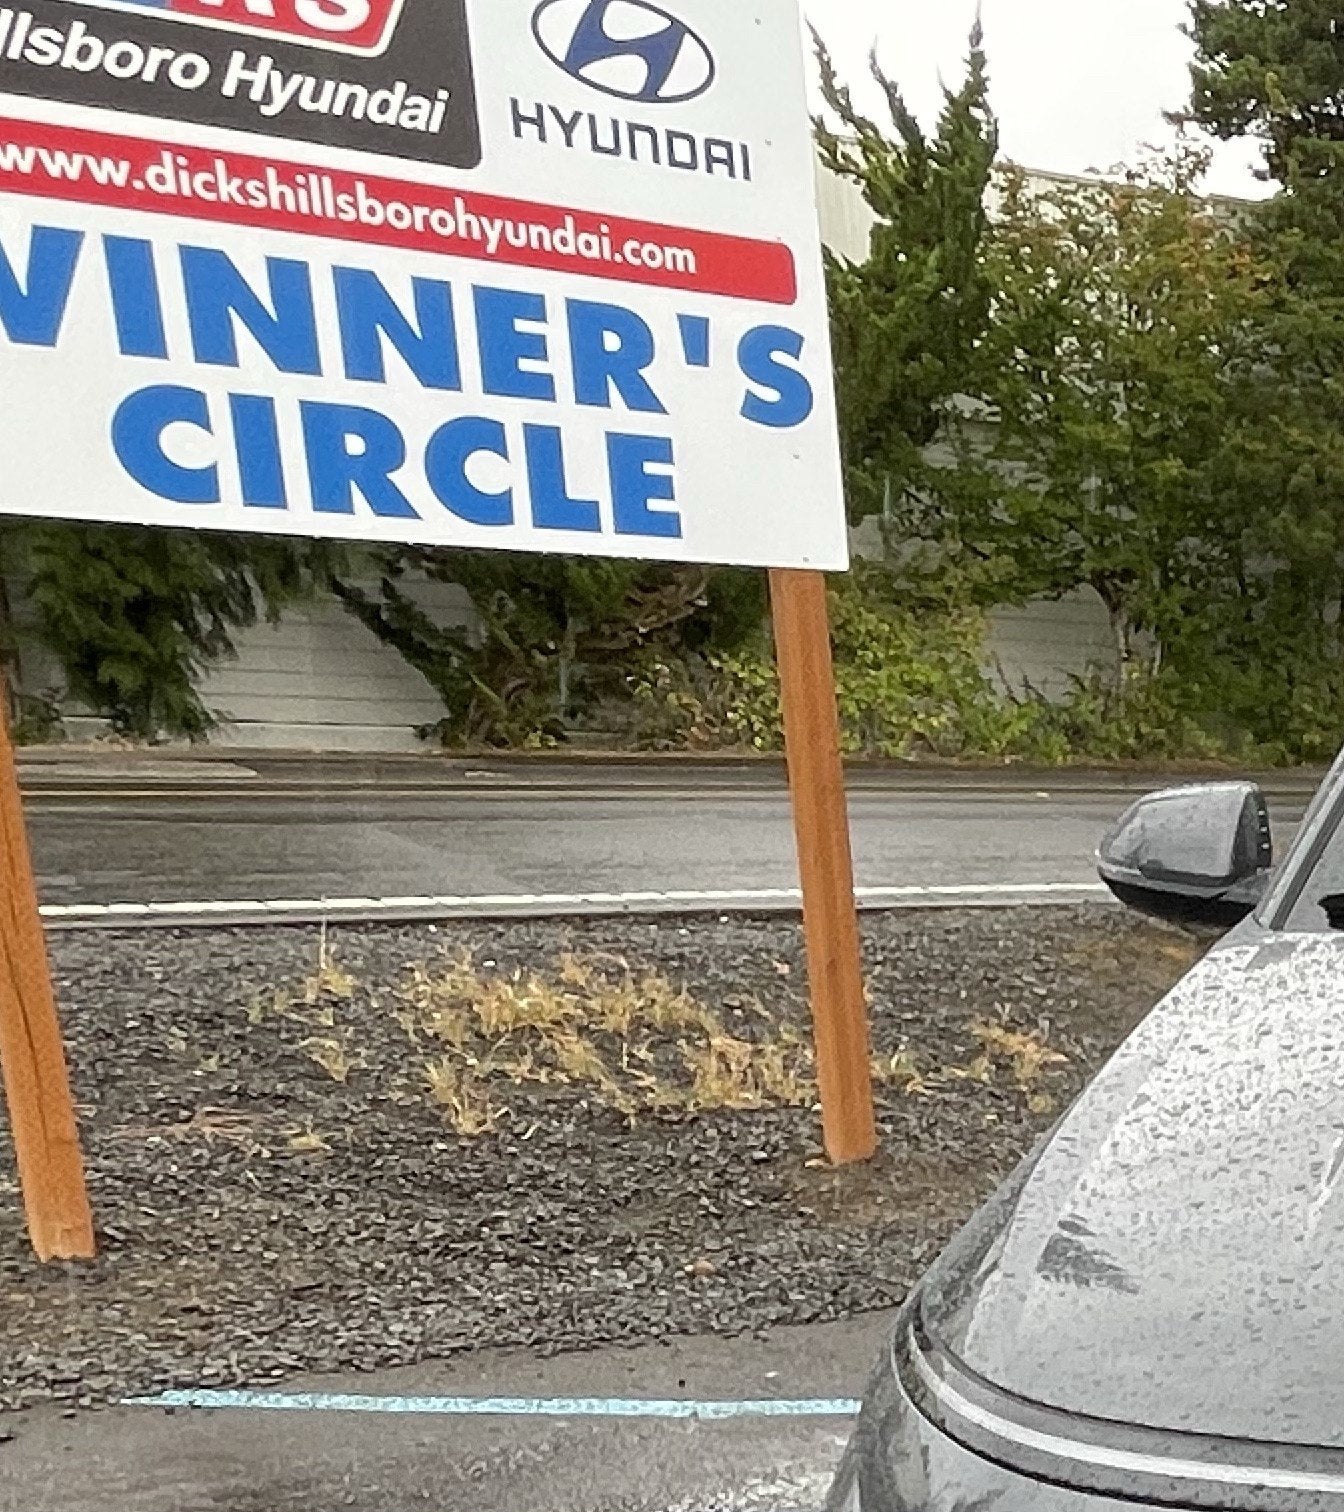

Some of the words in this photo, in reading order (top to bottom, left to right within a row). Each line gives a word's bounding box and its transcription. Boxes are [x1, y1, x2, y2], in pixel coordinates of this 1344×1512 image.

[221, 51, 449, 134] Hyundai
[510, 98, 752, 182] HYUNDAI
[0, 142, 697, 275] www.dickshillsborohyundai.com
[111, 384, 683, 539] CIRCLE
